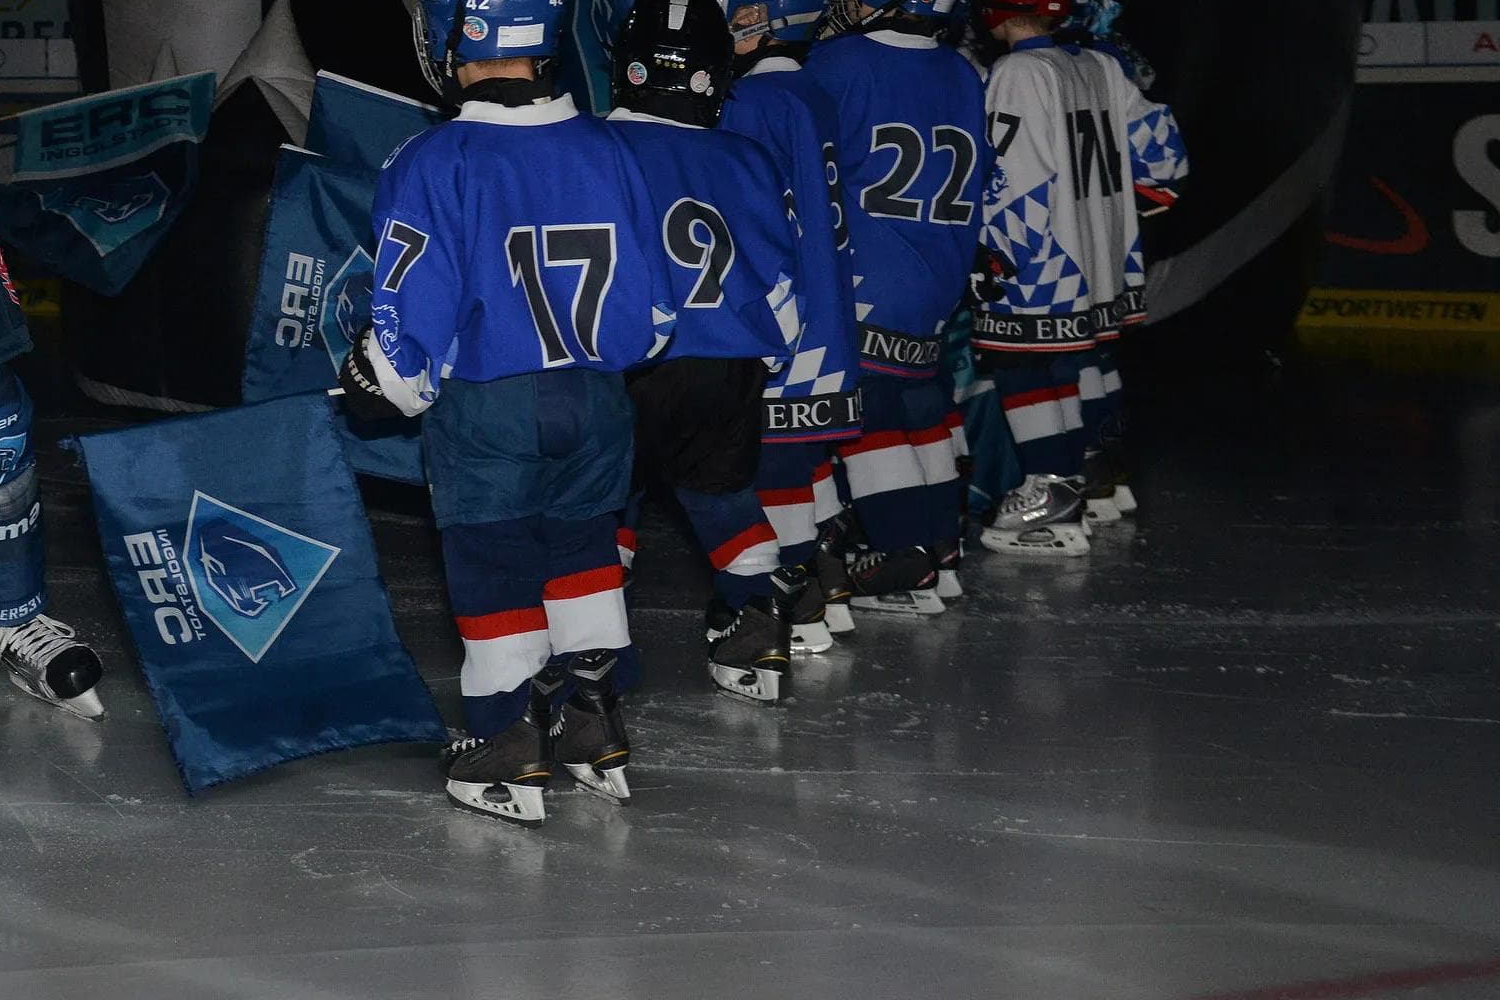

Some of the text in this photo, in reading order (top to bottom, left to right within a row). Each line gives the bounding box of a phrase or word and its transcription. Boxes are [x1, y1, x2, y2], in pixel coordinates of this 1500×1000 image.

[40, 117, 189, 162] INGOLSTADT
[41, 88, 190, 148] ERC
[859, 121, 978, 226] 22
[662, 195, 736, 310] 9
[503, 222, 619, 369] 17
[1304, 295, 1486, 323] SPORTWETTEN
[1036, 315, 1090, 341] ERC
[767, 399, 833, 430] ERC
